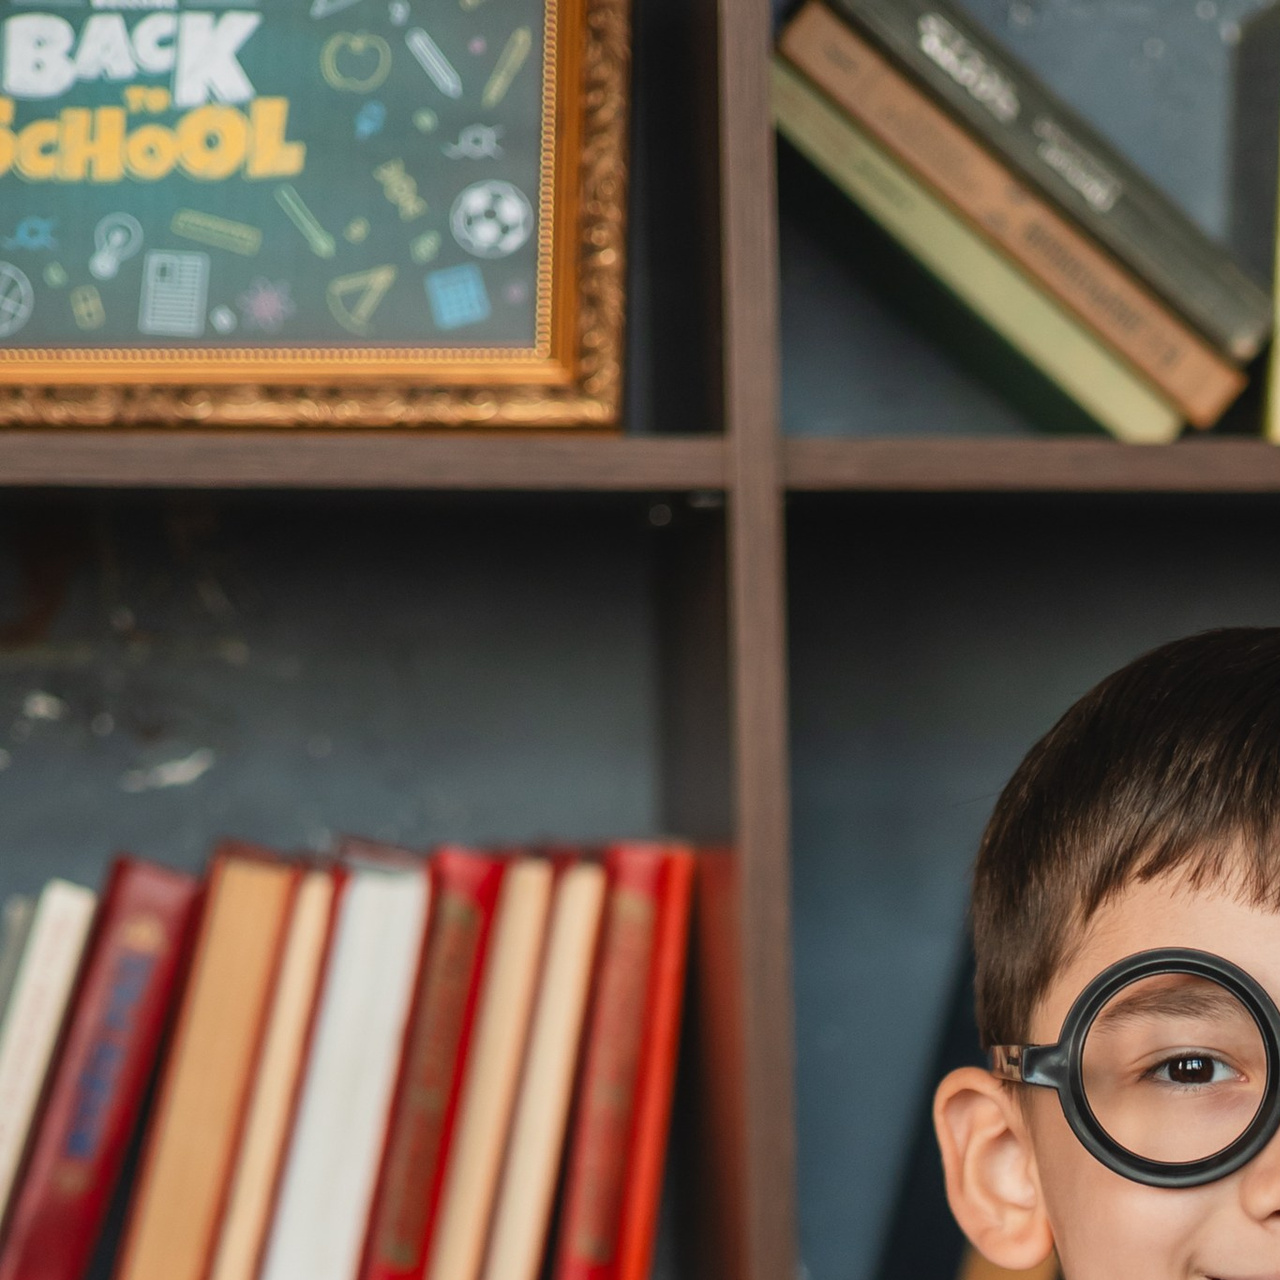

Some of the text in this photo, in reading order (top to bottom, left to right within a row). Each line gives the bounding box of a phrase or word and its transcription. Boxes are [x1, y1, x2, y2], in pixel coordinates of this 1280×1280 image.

[2, 11, 263, 107] BACK
[124, 85, 172, 114] TO
[0, 96, 307, 183] CHOOL
